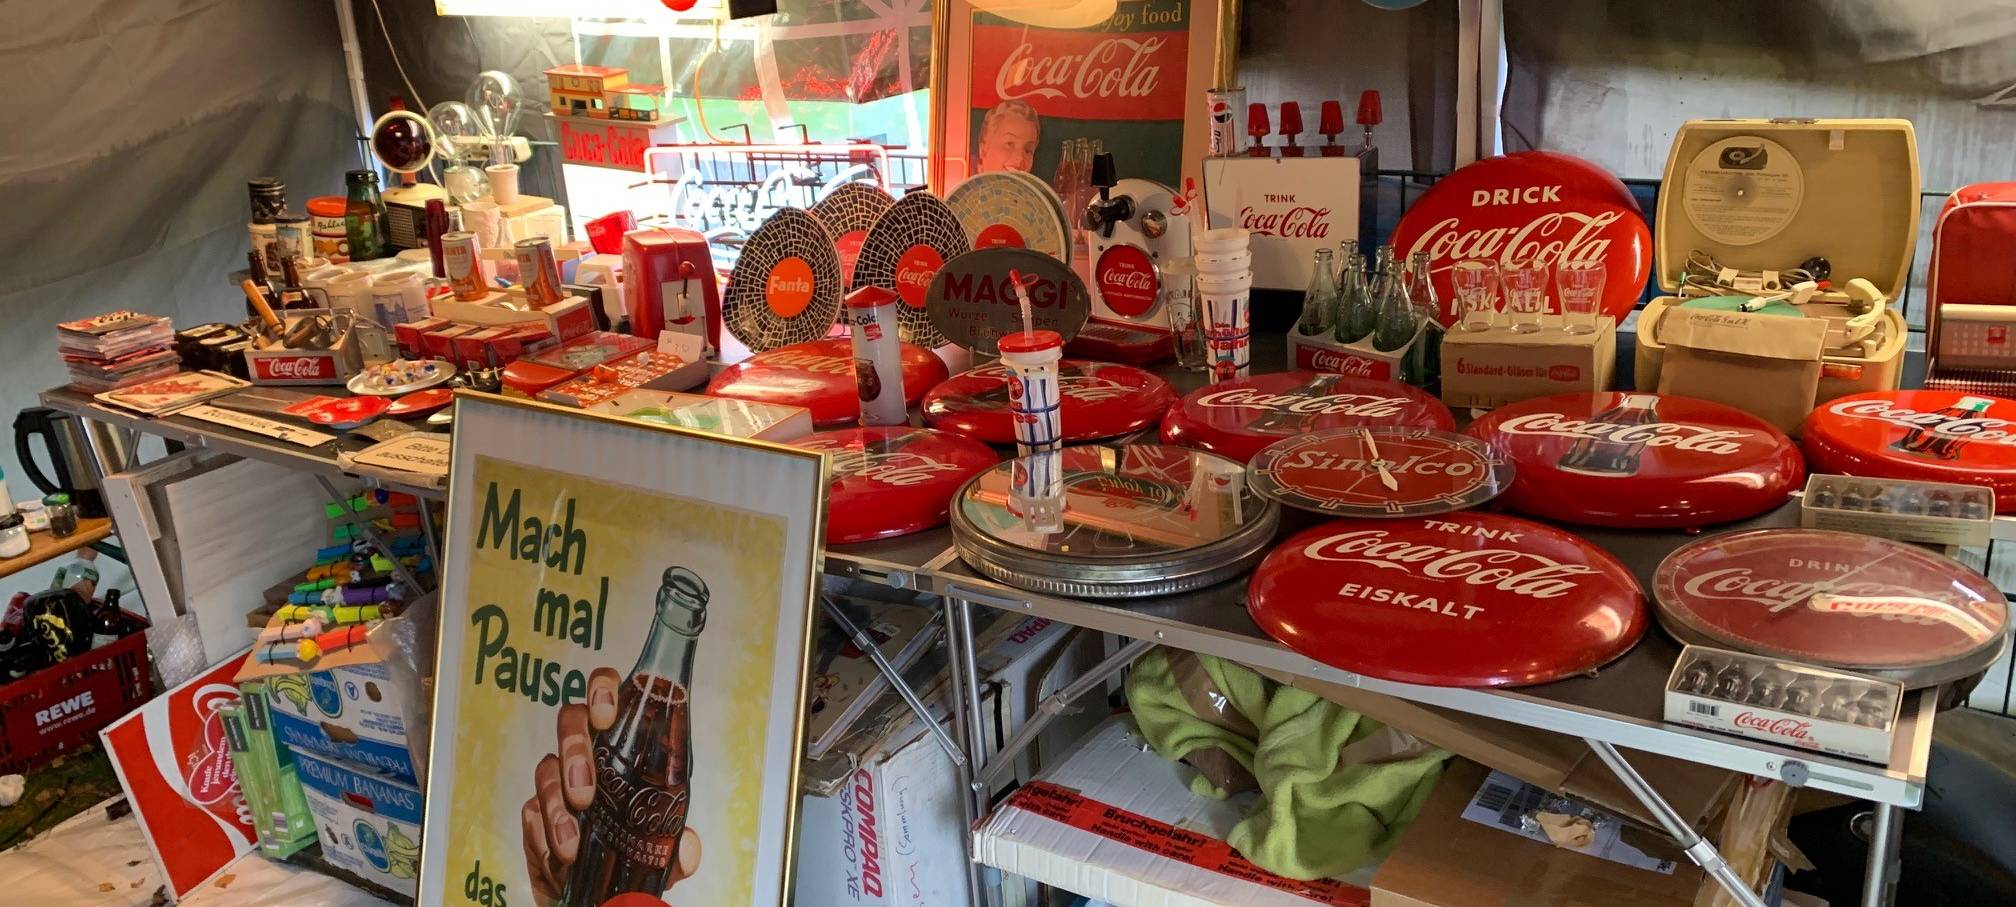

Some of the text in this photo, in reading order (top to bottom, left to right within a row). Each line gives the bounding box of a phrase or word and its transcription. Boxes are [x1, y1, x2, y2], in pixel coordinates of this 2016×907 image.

[1142, 5, 1182, 25] food
[995, 36, 1168, 99] Coca-Cola
[1264, 194, 1296, 204] TRINK
[1471, 184, 1562, 207] DRICK
[1405, 210, 1625, 275] Coca-Cola
[769, 275, 810, 295] Fanta
[1104, 268, 1151, 291] Coca-Cola
[269, 357, 321, 378] Coca-Cola
[1311, 350, 1374, 377] Coca-Cola
[1456, 356, 1466, 375] 6
[1197, 388, 1412, 418] Coca-Cola
[1498, 413, 1755, 455] Coca-Cola
[476, 481, 588, 575] Mach
[1424, 519, 1525, 544] TRINK
[1303, 529, 1604, 600] Coca-Cola
[533, 576, 610, 651] mal
[1337, 582, 1486, 621] EISKALT
[471, 603, 588, 707] Pause
[35, 691, 95, 726] REWE
[38, 707, 97, 737] www.rewe.de
[1733, 711, 1813, 740] Coca-Cola
[201, 765, 213, 793] Kaufe
[303, 759, 415, 811] PREMIUM BANANAS
[854, 767, 883, 898] COMPAQ
[1091, 823, 1132, 844] Handle
[1134, 837, 1160, 852] with
[1162, 846, 1195, 865] care!
[1103, 807, 1207, 848] Bruchgefahr!
[463, 860, 507, 907] das
[845, 869, 861, 902] XE
[1217, 863, 1263, 883] Handle
